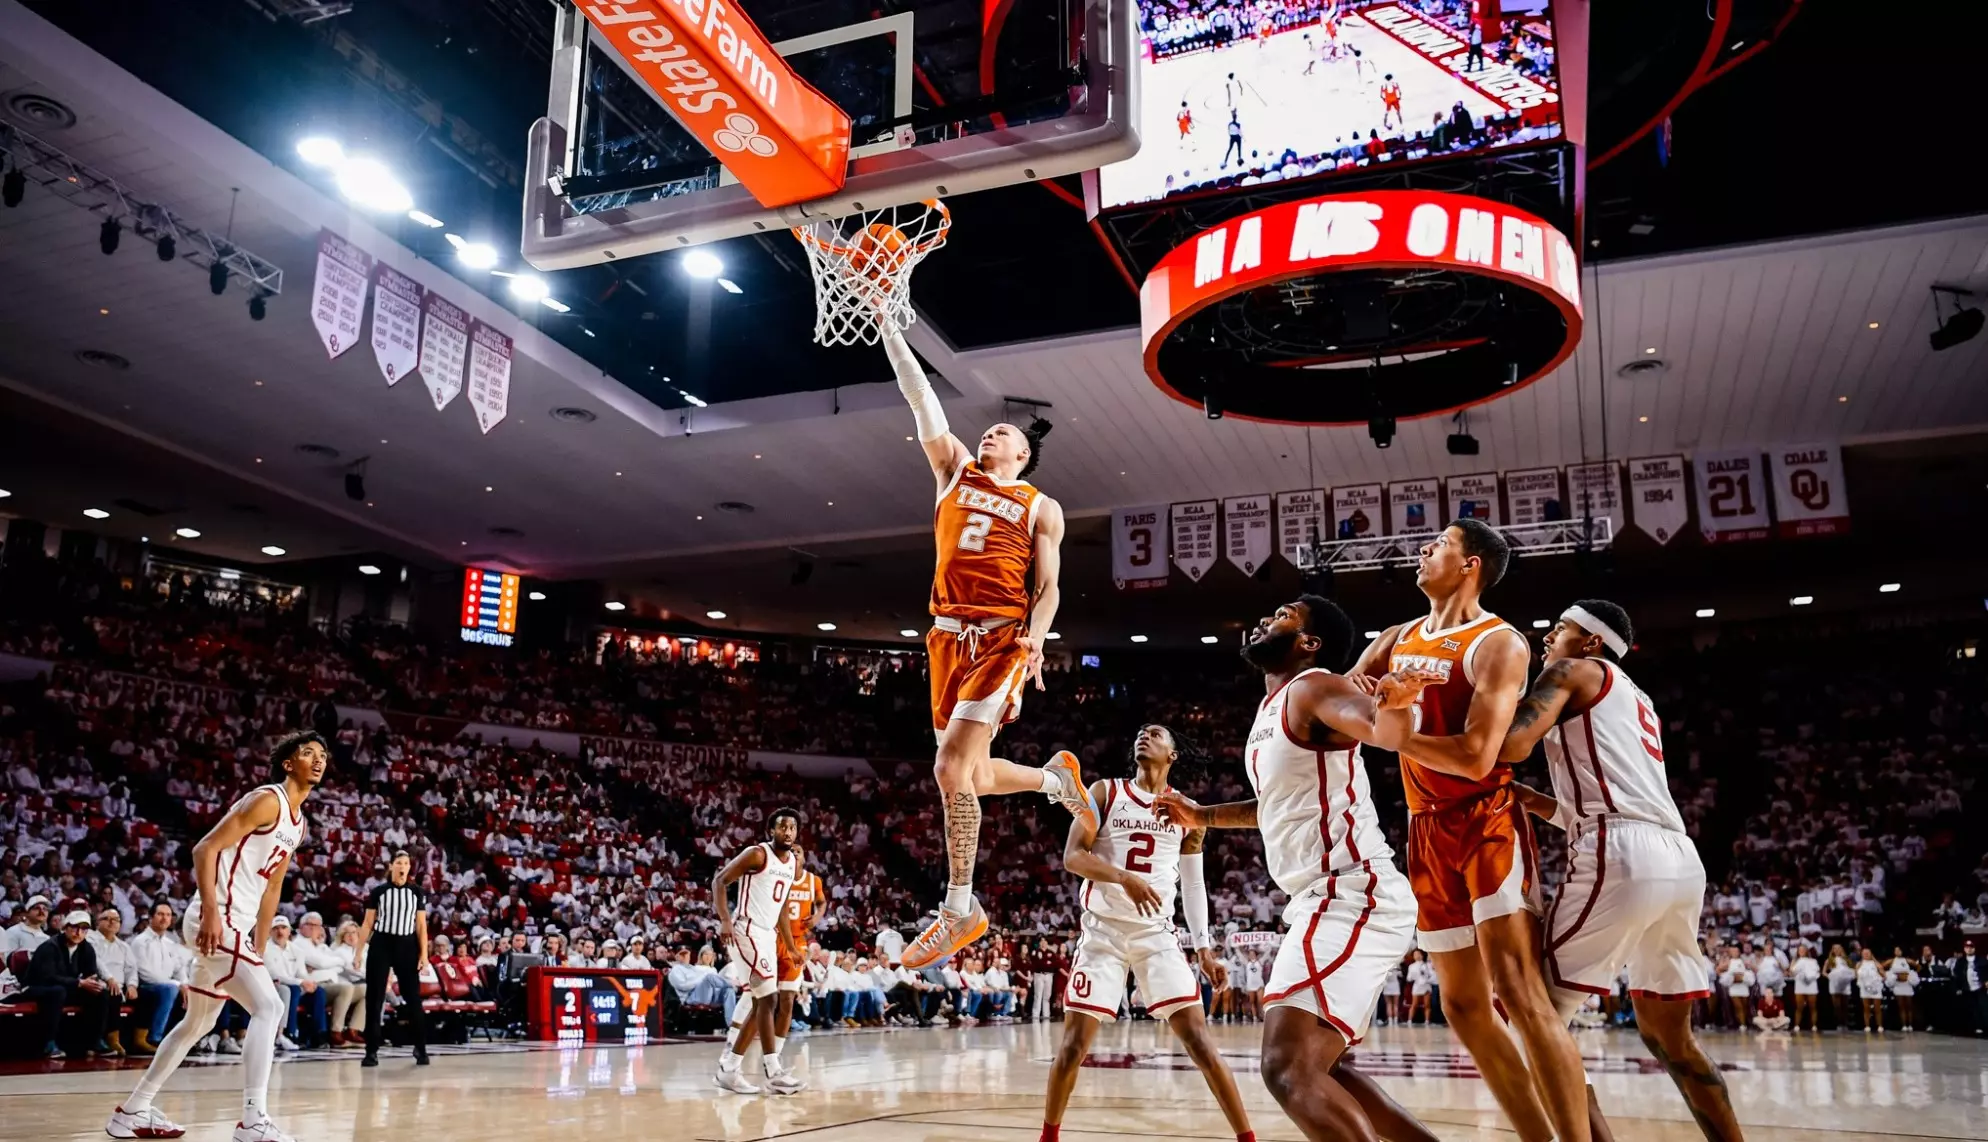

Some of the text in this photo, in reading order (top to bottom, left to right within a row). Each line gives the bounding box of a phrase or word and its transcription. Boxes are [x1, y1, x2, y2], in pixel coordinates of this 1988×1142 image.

[627, 24, 738, 114] State
[1707, 458, 1750, 473] DALES
[1784, 450, 1828, 466] COALE
[1404, 484, 1424, 493] NCAA
[1462, 479, 1483, 488] NCAA
[1790, 469, 1830, 510] OU
[1290, 495, 1312, 504] NCAA
[1347, 489, 1367, 498] NCAA
[1643, 488, 1674, 503] 1994
[1708, 473, 1756, 518] 21
[956, 484, 1026, 524] TEXAS
[1184, 506, 1206, 515] NCAA
[1236, 501, 1258, 511] NCAA
[1282, 503, 1311, 514] SWEET
[1124, 513, 1157, 527] PARIS
[957, 512, 993, 553] 2
[1130, 529, 1152, 567] 3
[671, 744, 748, 769] SOONER
[1112, 818, 1177, 835] OKLAHOMA
[1125, 832, 1156, 874] 2
[772, 880, 785, 903] 0
[1233, 933, 1275, 944] NOISE!
[1072, 971, 1092, 998] OU
[565, 991, 576, 1012] 2
[630, 991, 640, 1011] 7
